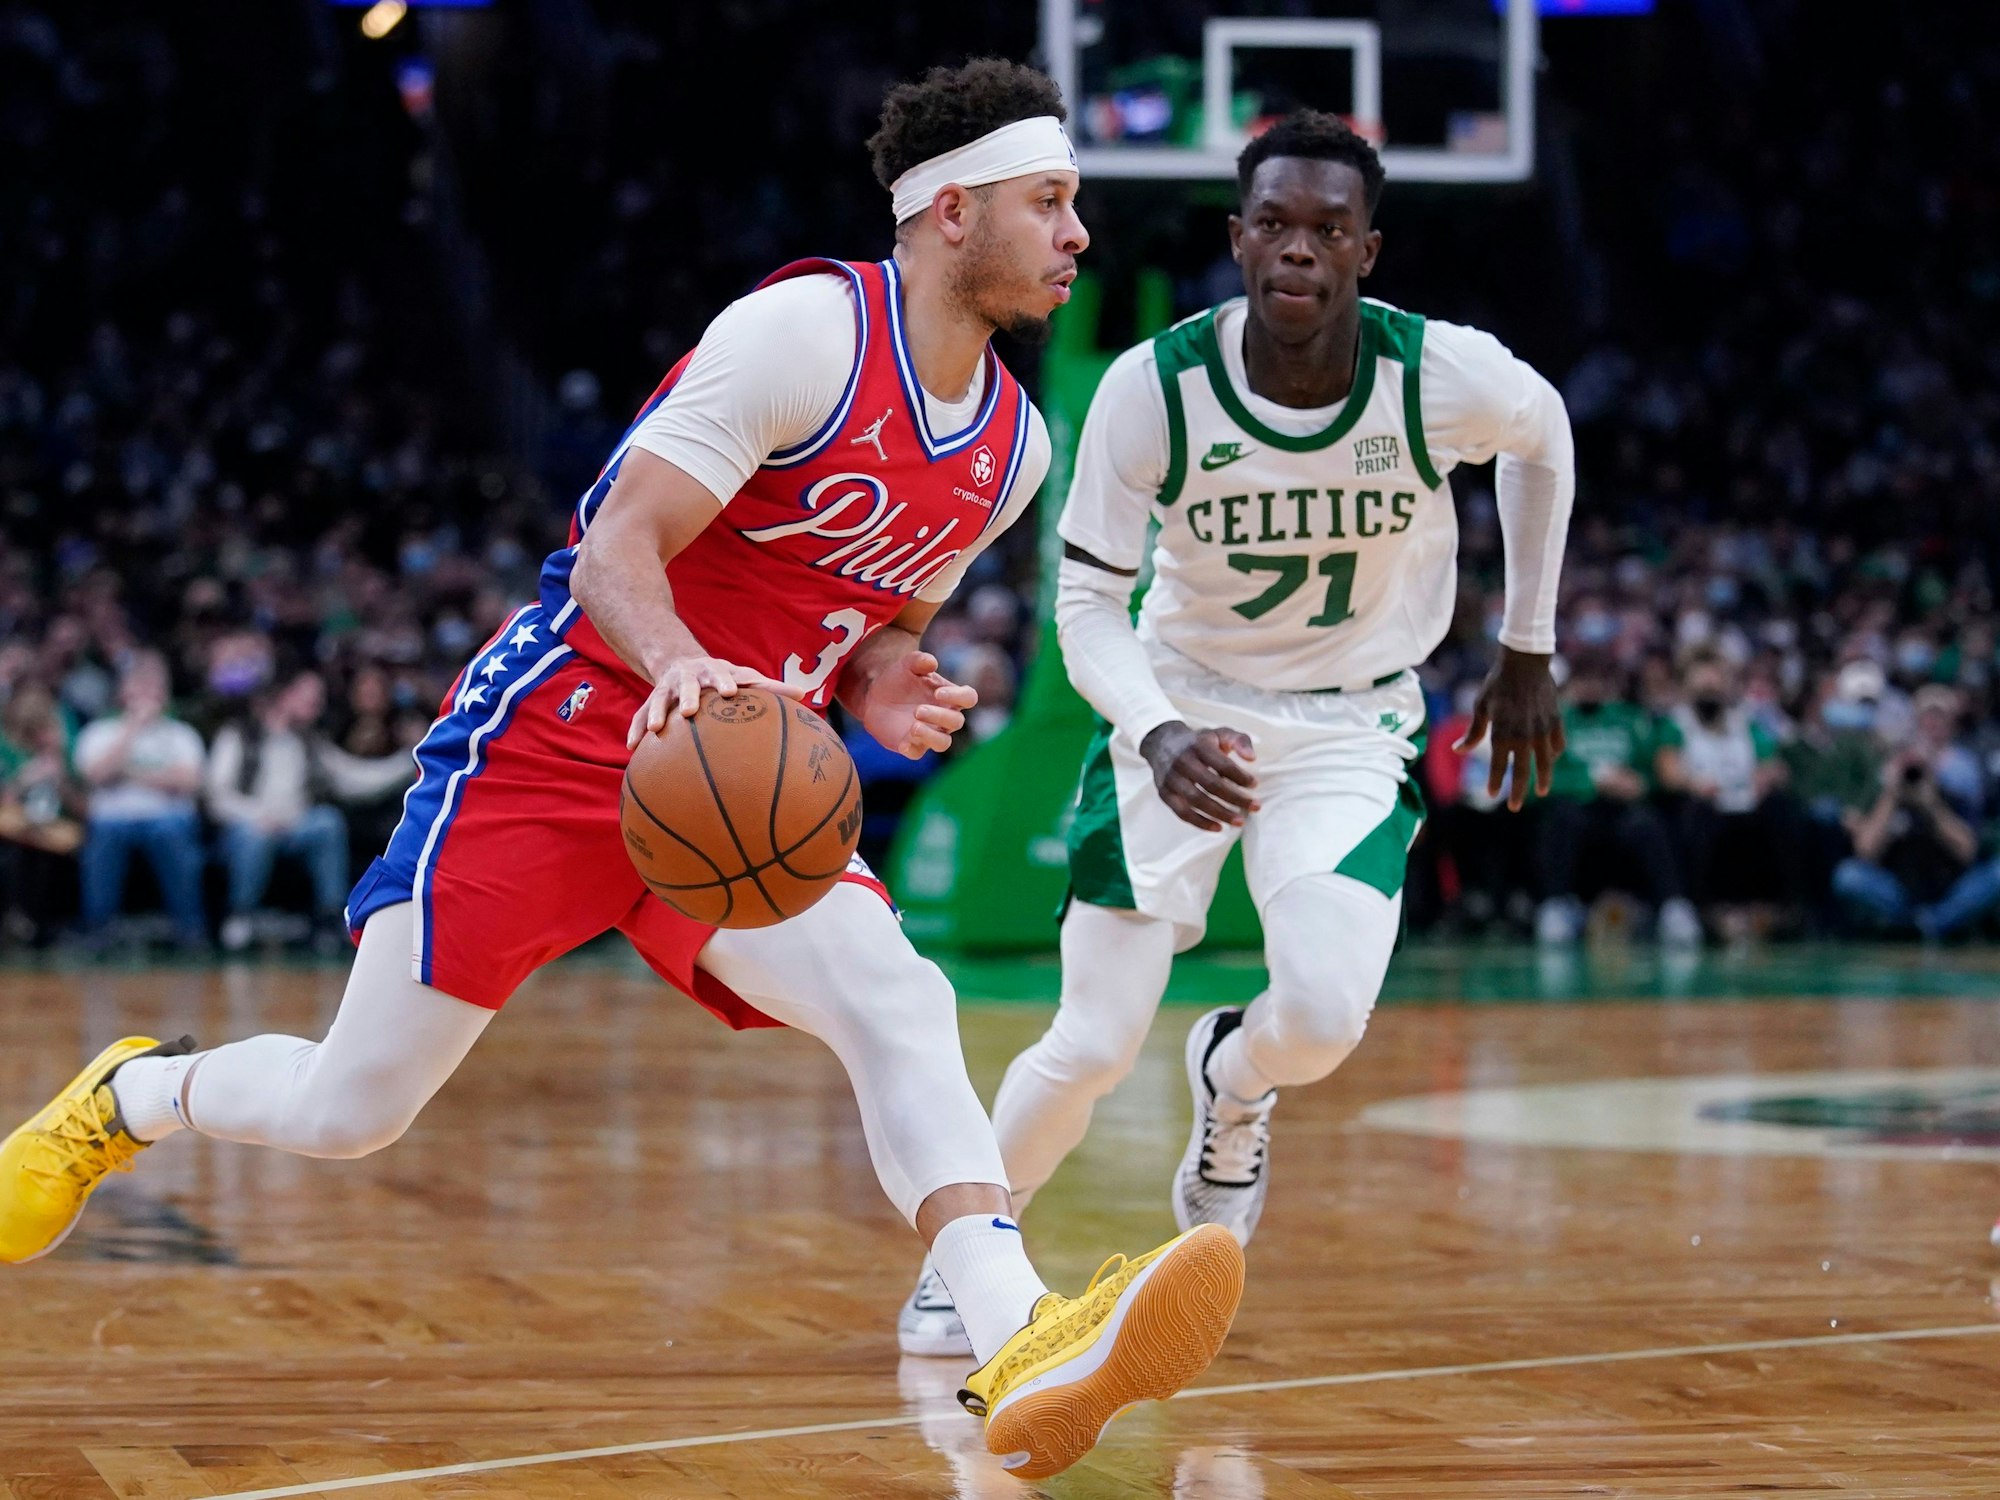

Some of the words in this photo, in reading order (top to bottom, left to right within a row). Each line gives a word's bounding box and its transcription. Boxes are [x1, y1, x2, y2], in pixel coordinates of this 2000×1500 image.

[1353, 436, 1399, 458] VISTA
[1355, 455, 1399, 476] PRINT
[952, 486, 992, 509] crypto.com
[1187, 488, 1415, 545] CELTICS
[1227, 551, 1358, 628] 71
[782, 607, 882, 705] 3
